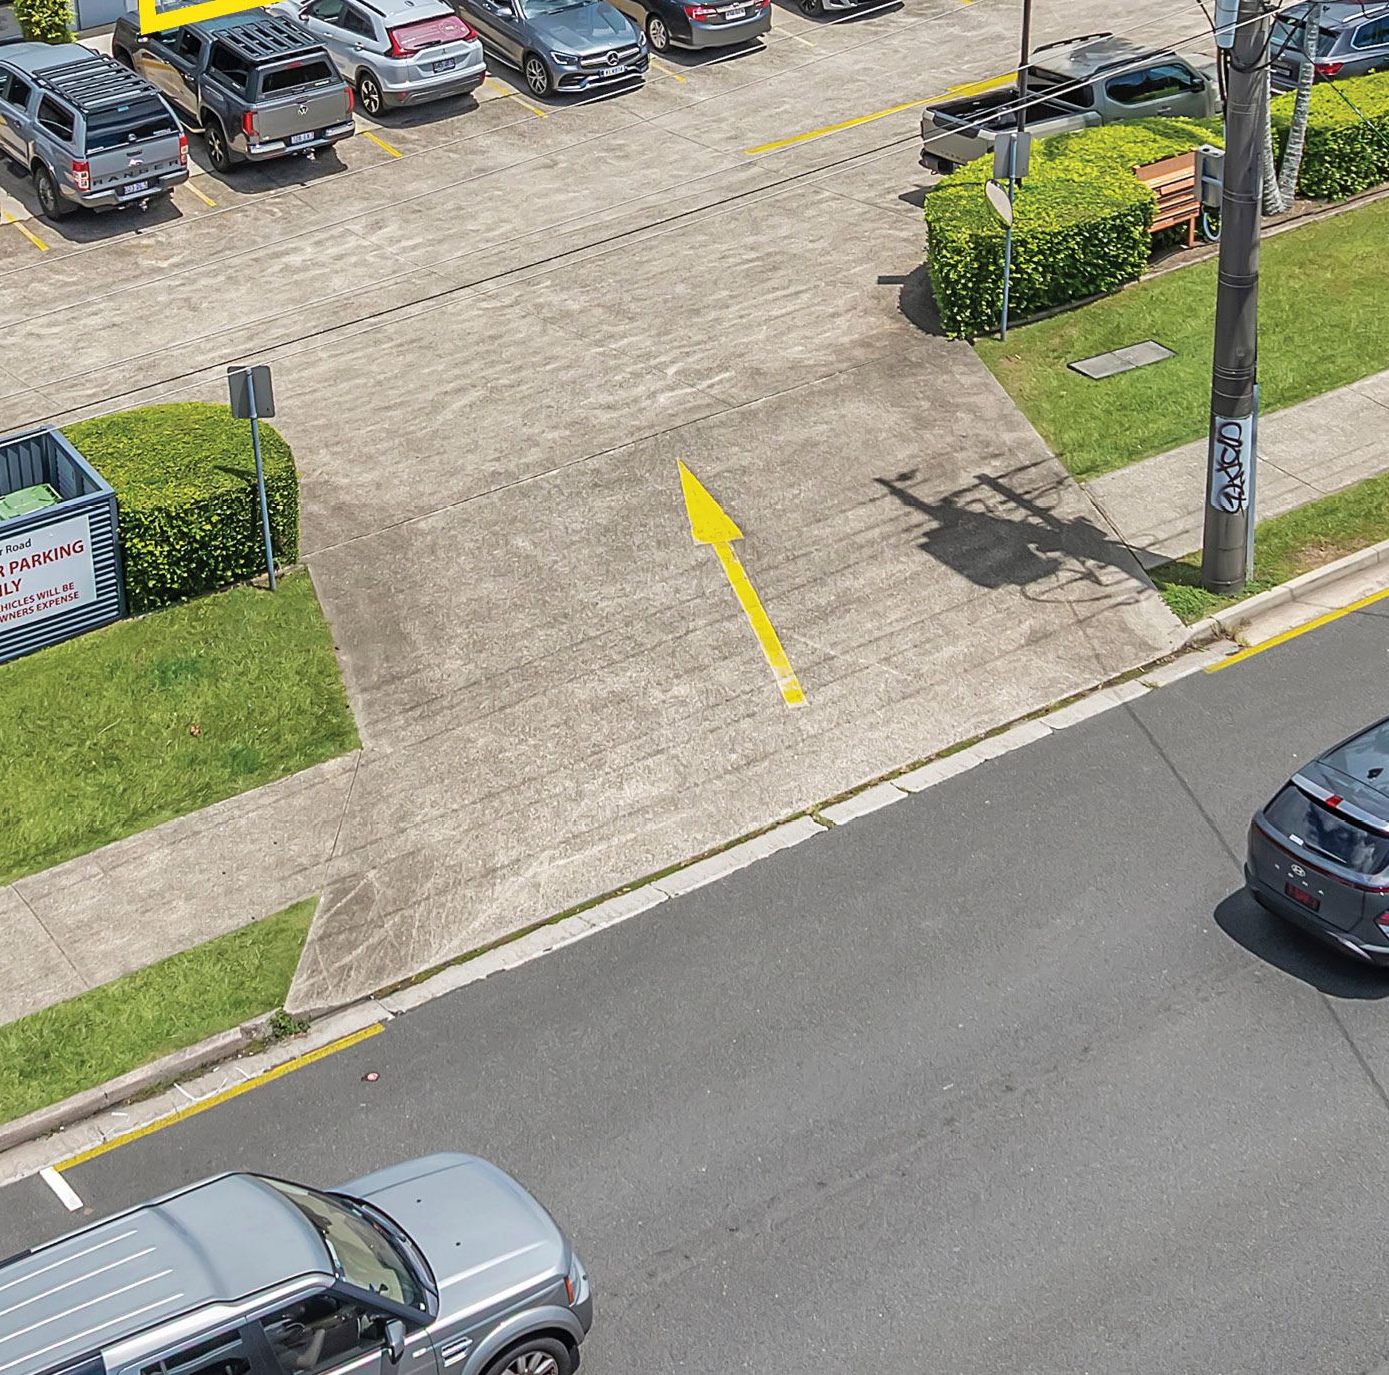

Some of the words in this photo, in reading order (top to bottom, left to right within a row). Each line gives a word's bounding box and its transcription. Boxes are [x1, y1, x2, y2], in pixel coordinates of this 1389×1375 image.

[5, 538, 32, 554] Road
[9, 539, 84, 575] PARKING
[36, 586, 61, 601] WILL
[62, 582, 75, 593] BE
[36, 591, 80, 612] EXPENSE
